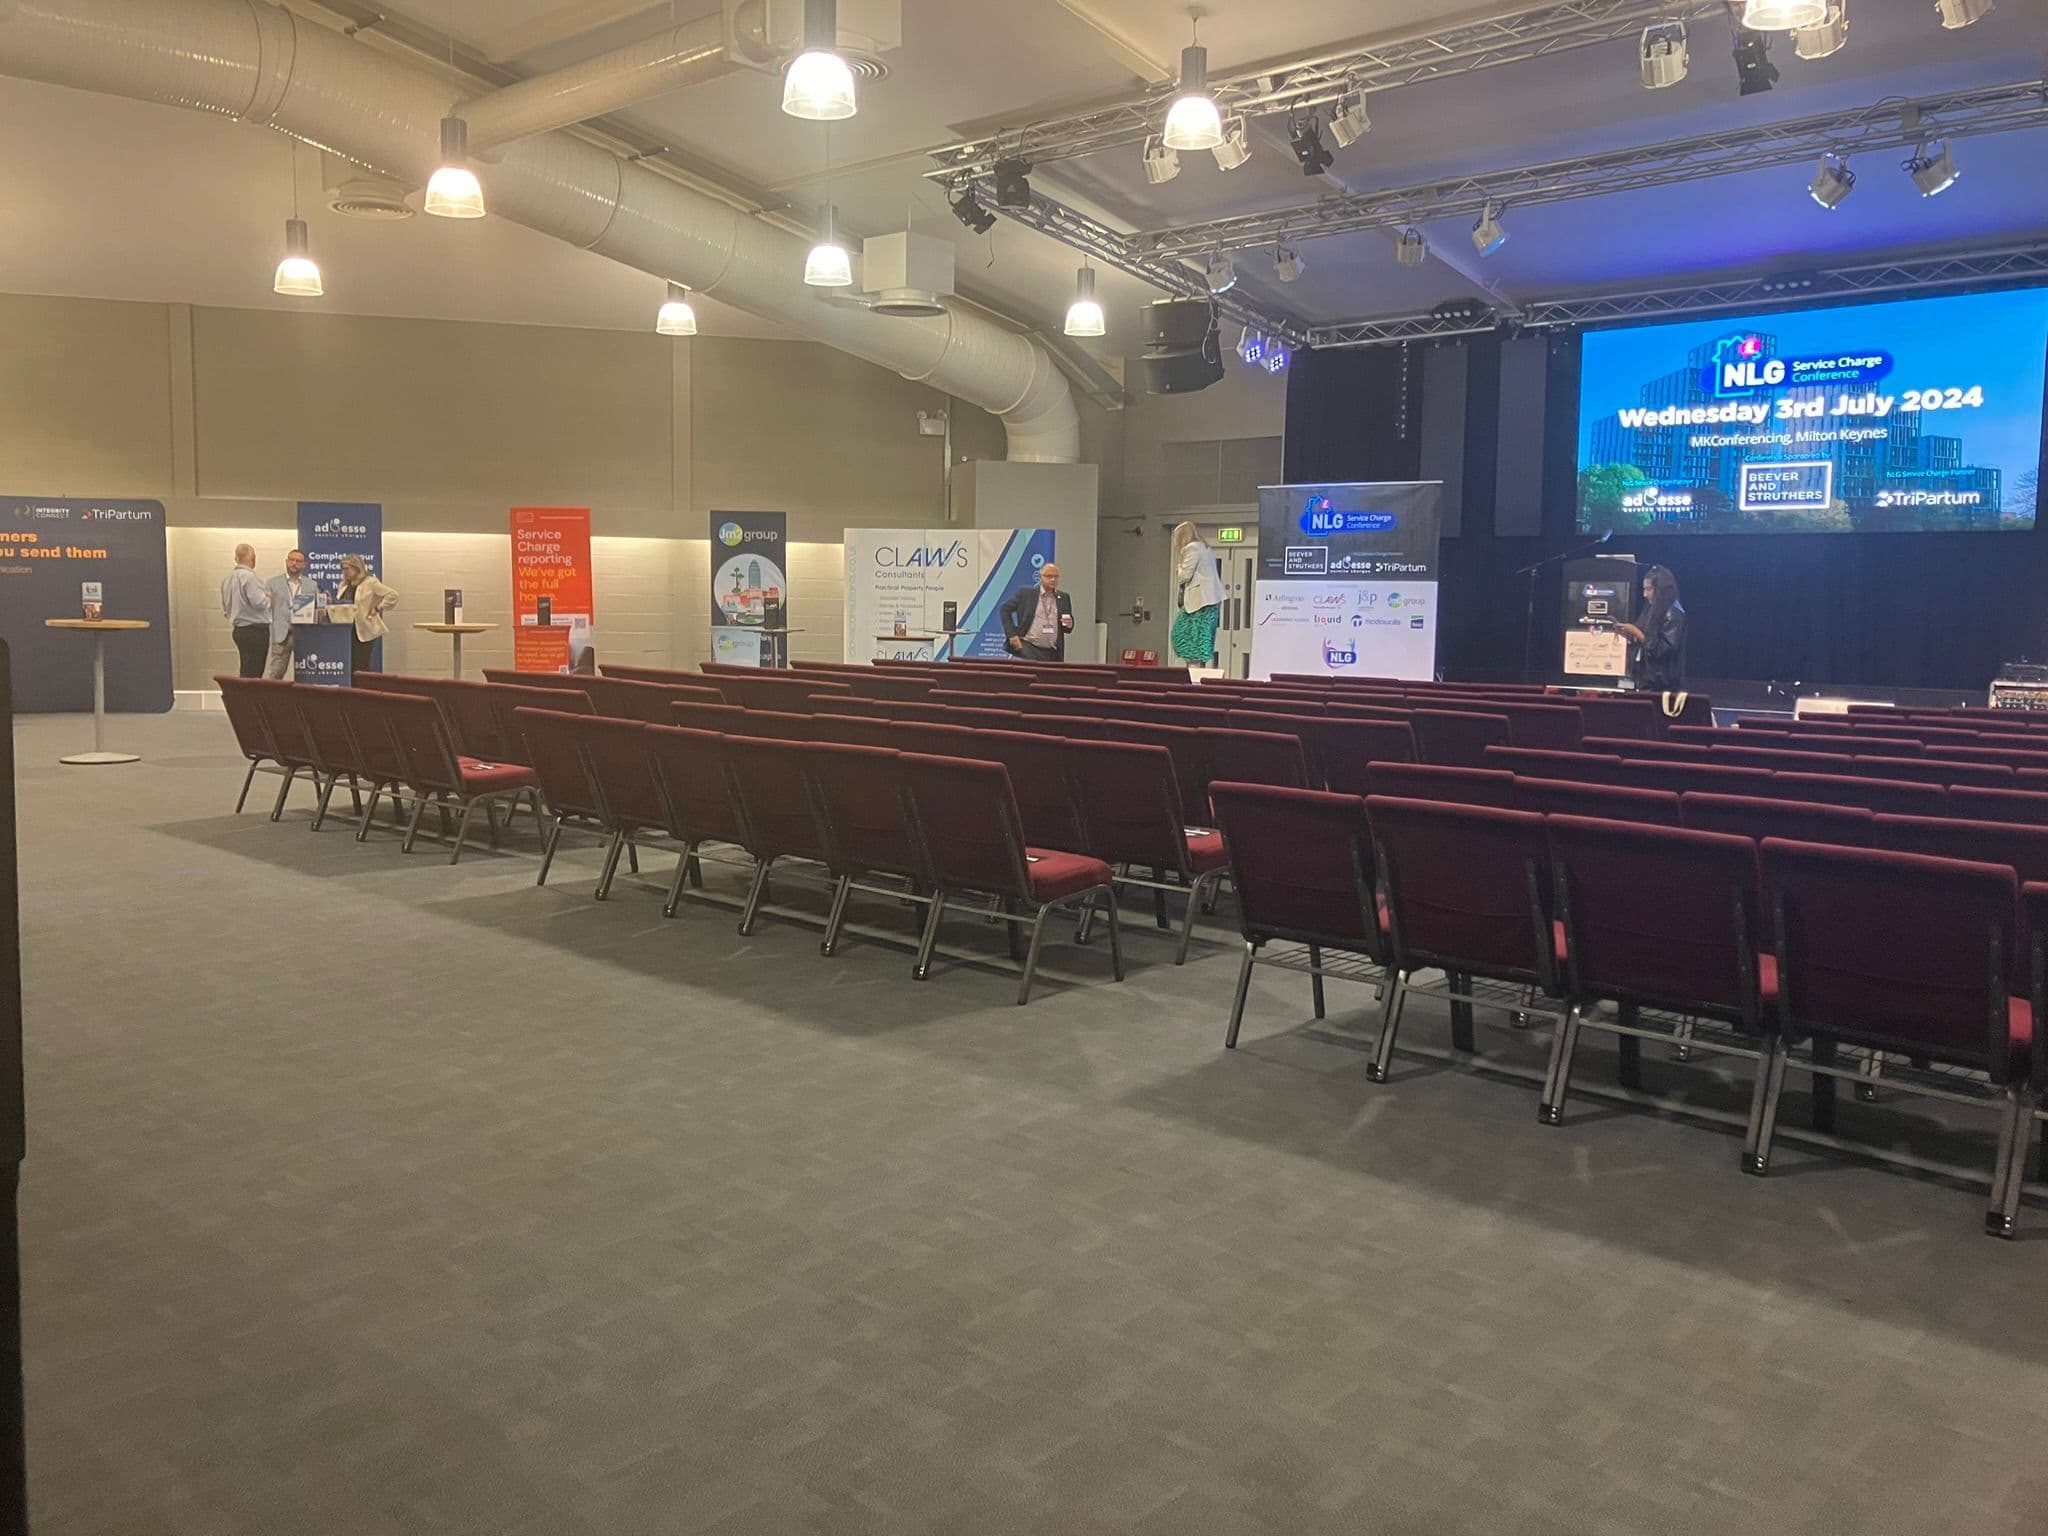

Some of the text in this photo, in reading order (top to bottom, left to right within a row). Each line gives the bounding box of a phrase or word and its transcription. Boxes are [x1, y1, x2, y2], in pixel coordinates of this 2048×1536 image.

[1792, 355, 1883, 372] Service Charge
[1723, 360, 1786, 388] NLG
[1792, 369, 1860, 383] Conference
[1618, 385, 1985, 428] Wednesday 3rd July 2024
[1690, 426, 1888, 449] MKConferencing, Milton Keynes
[1749, 472, 1799, 482] BEEVER
[1886, 470, 1902, 478] NLG
[1926, 469, 1950, 477] Charge
[1749, 482, 1776, 492] AND
[1748, 491, 1823, 502] STRUTHERS
[1892, 491, 1980, 506] TriPartum
[92, 508, 152, 520] TriPartum
[1347, 513, 1392, 522] Service Charge
[1311, 513, 1344, 530] NLG
[1346, 521, 1381, 529] Conference
[517, 529, 562, 540] Service
[20, 546, 61, 558] send
[66, 546, 107, 559] them
[517, 541, 561, 554] Charge
[308, 551, 347, 563] Complet
[518, 553, 573, 567] reporting
[557, 566, 577, 580] got
[1382, 561, 1427, 573] TriPartum
[874, 570, 925, 579] Consultants
[519, 577, 560, 589] the full
[1313, 613, 1342, 626] liquid
[1329, 652, 1353, 663] NLG
